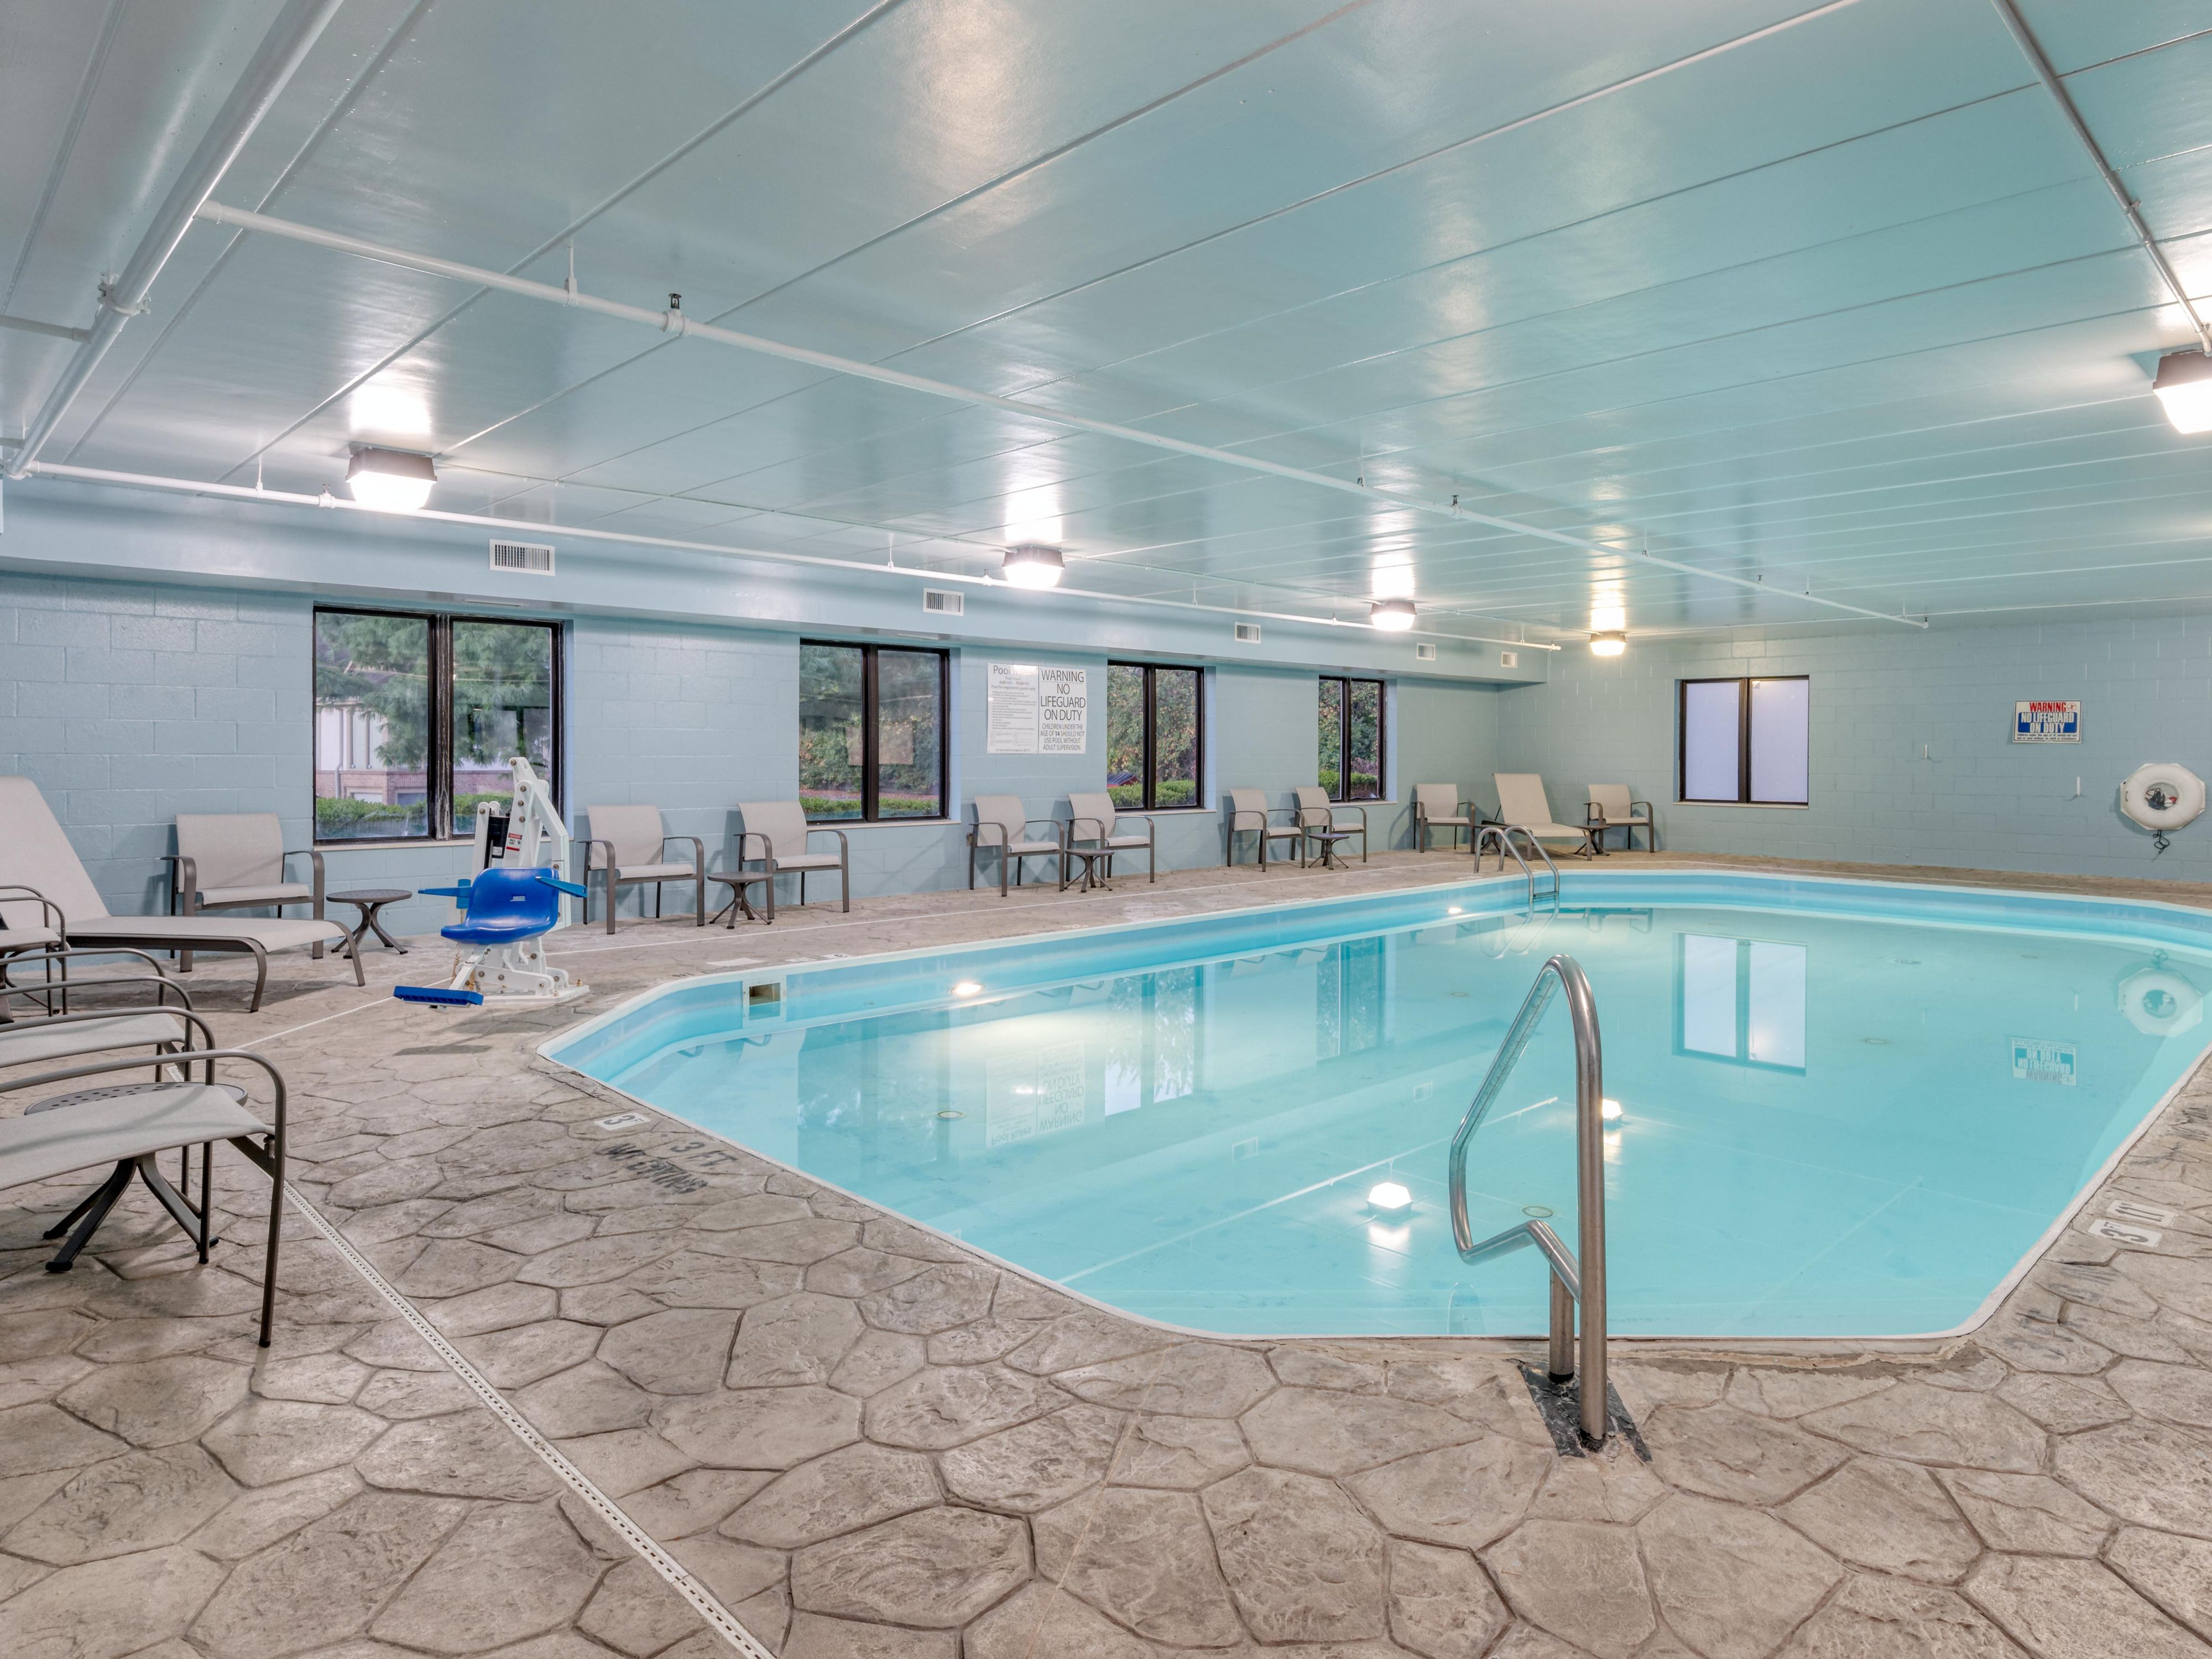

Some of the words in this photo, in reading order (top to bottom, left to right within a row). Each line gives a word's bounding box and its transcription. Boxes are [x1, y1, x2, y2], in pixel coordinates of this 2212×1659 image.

[993, 665, 1010, 675] Pool
[1041, 670, 1084, 682] WARNING
[1057, 684, 1070, 695] NO
[1041, 696, 1086, 708] LIFEGUARD
[2030, 702, 2066, 712] WARNING
[1044, 709, 1057, 720] ON
[1060, 709, 1082, 721] DUTY
[2021, 712, 2032, 723] NO
[2033, 712, 2074, 723] LIFEGUARD
[2030, 722, 2041, 733] ON
[2043, 722, 2065, 733] DUTY
